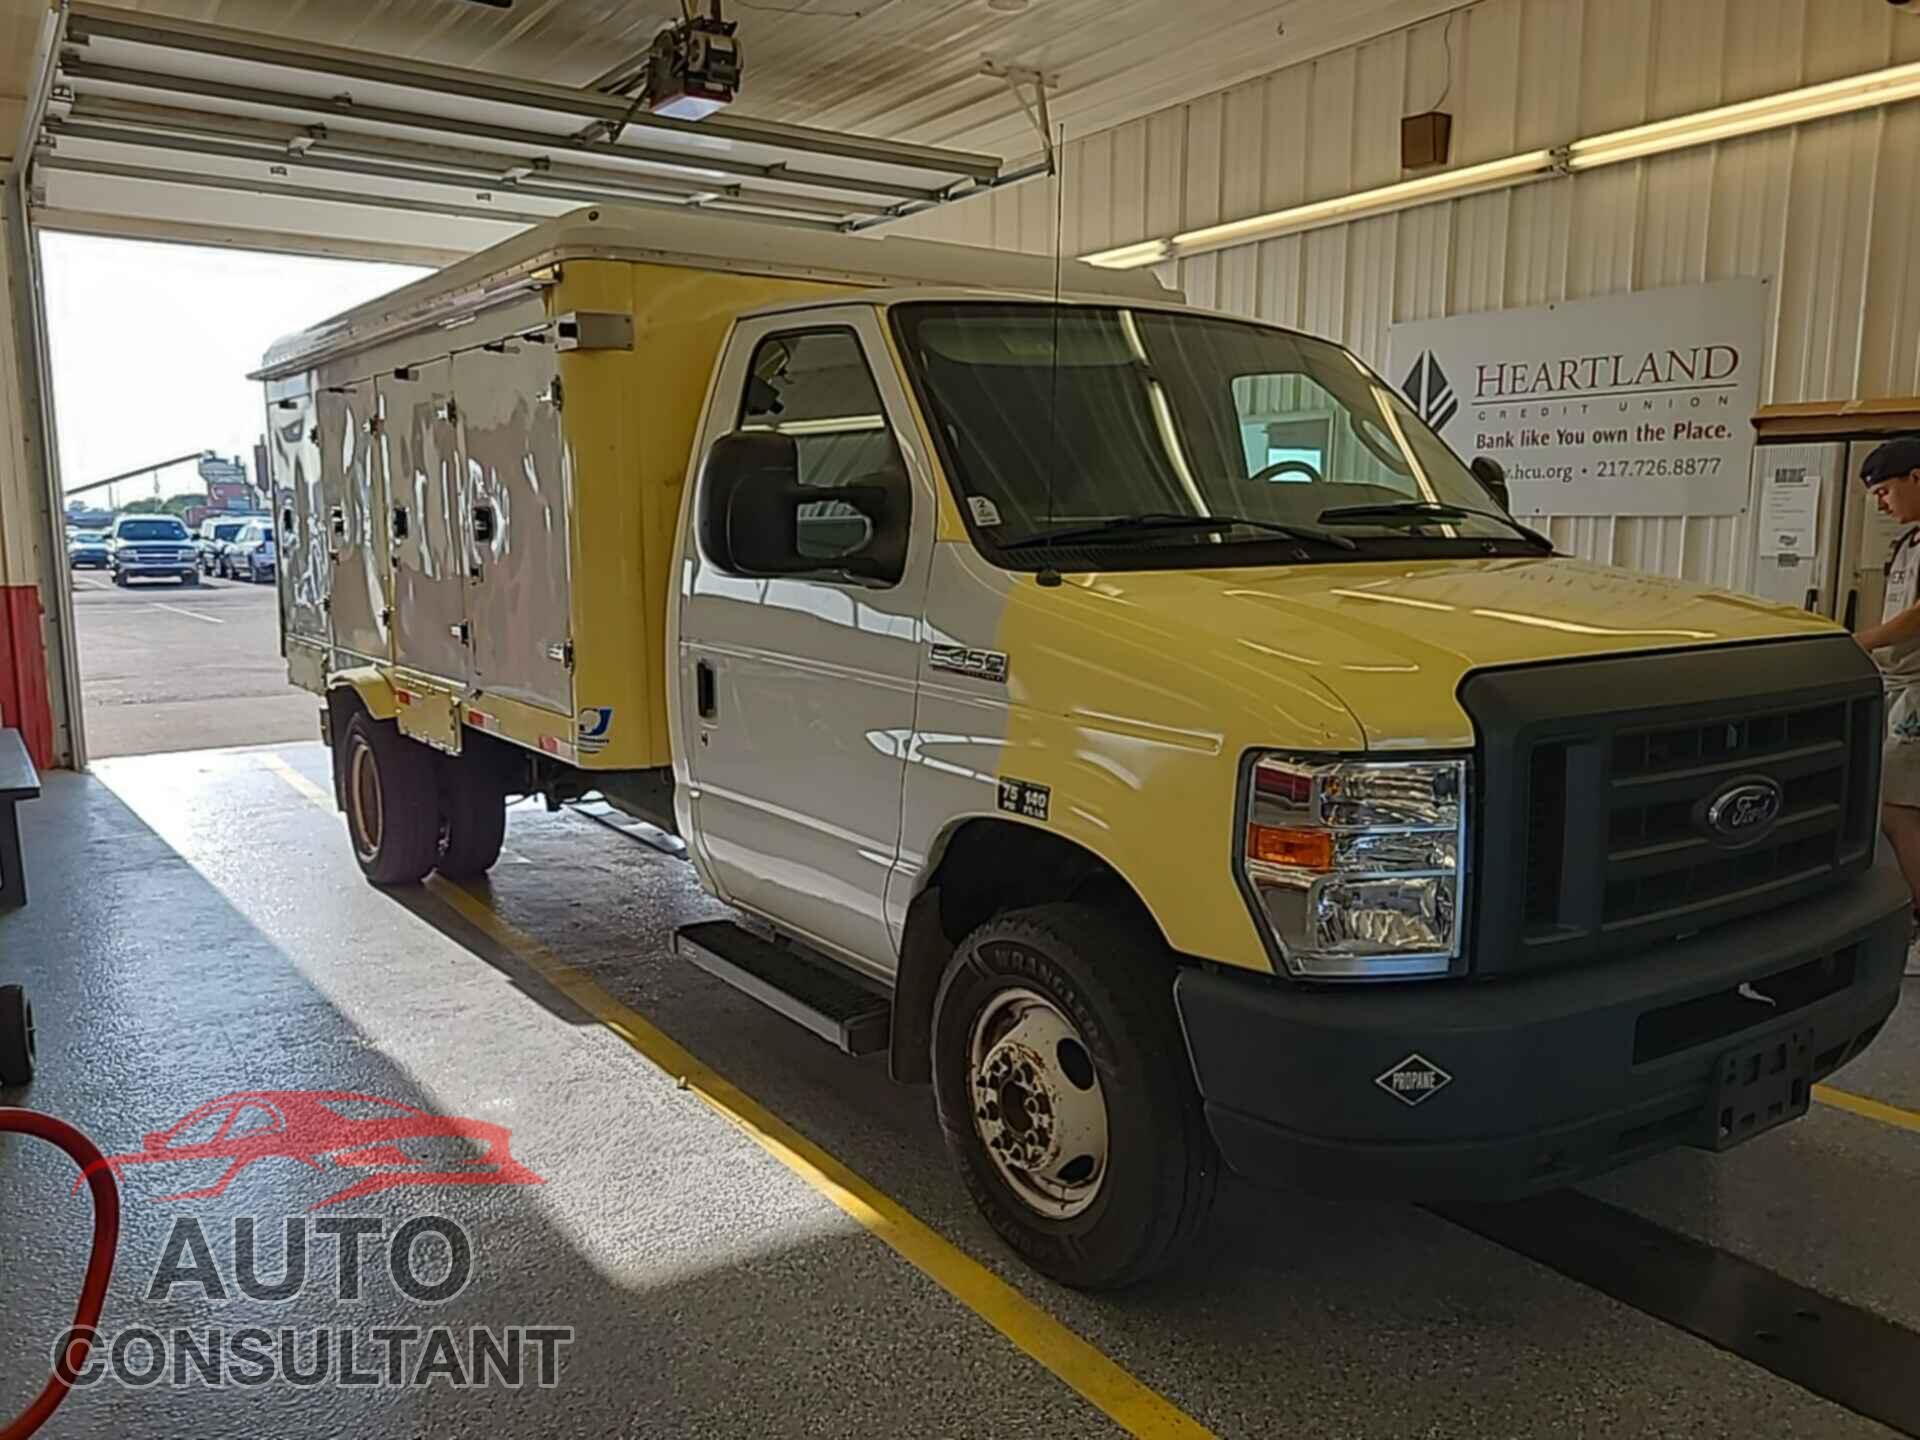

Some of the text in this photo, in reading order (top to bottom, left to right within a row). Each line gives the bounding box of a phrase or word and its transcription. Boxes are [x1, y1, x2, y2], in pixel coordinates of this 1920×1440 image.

[1475, 345, 1739, 397] HEARTLAND
[1477, 395, 1729, 421] CREDIT UNION
[1476, 420, 1733, 450] Bank like You own the Place.
[1597, 457, 1721, 477] 217.726.8877
[1392, 1071, 1436, 1091] PROPANE
